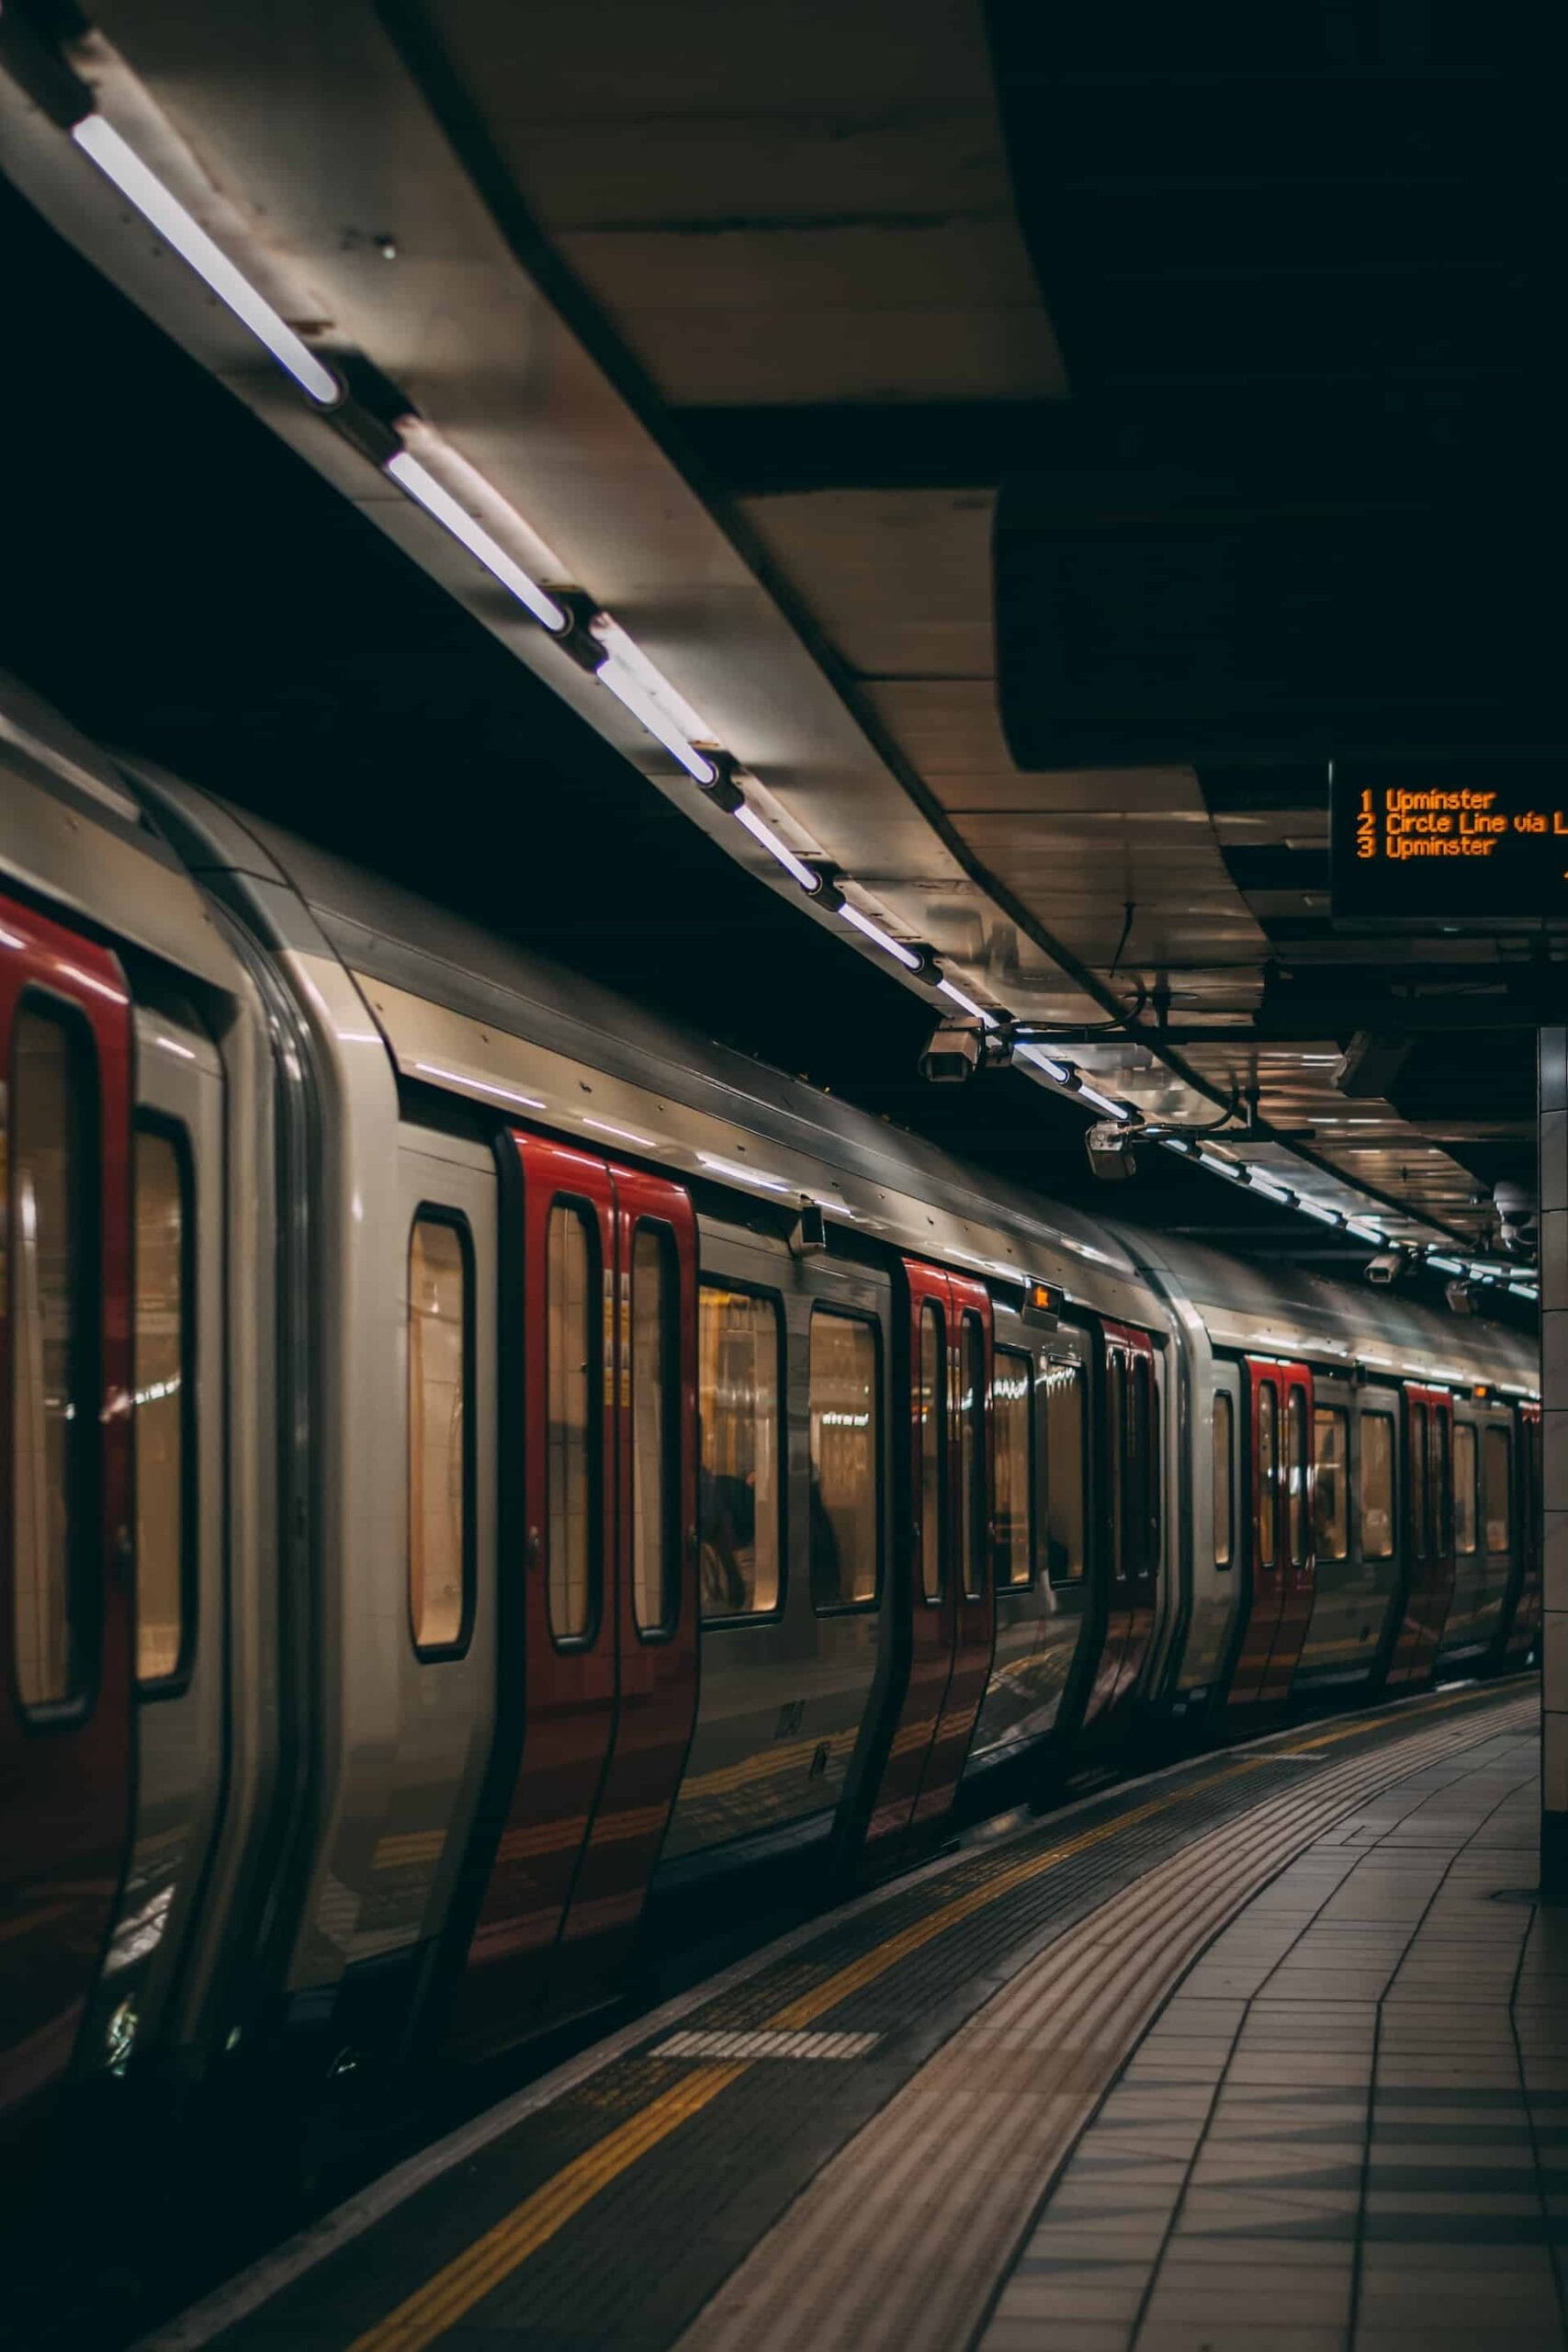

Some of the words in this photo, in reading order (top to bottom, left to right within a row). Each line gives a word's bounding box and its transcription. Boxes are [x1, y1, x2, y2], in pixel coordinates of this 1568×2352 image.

[1361, 789, 1372, 811] 1
[1386, 789, 1496, 812] Upminster
[1357, 813, 1376, 834] 2
[1386, 812, 1452, 834] Circle
[1459, 813, 1507, 834] Line
[1514, 812, 1547, 832] via
[1357, 835, 1376, 858] 3
[1386, 835, 1496, 859] Upminster
